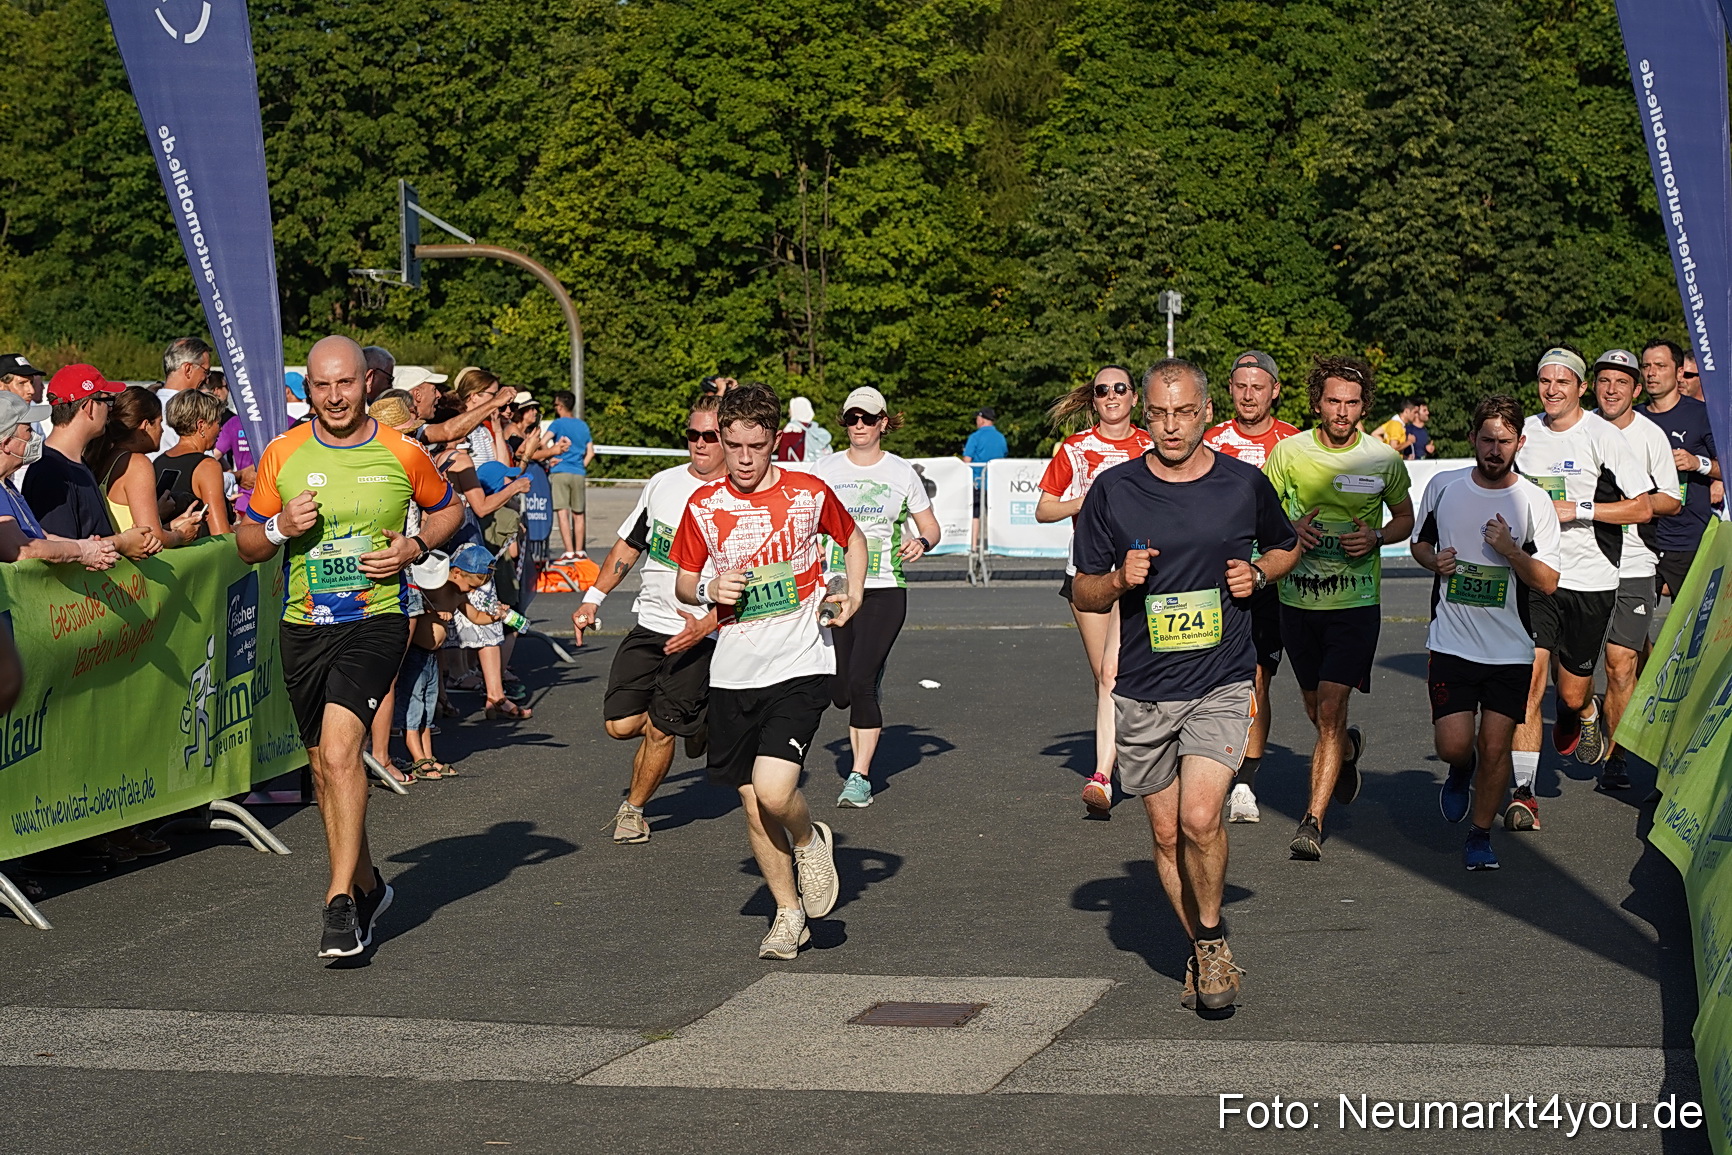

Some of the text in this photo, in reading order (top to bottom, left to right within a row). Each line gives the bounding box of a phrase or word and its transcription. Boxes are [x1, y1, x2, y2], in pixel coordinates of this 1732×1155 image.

[847, 505, 885, 513] aufend
[1012, 503, 1034, 513] E-B
[853, 513, 888, 524] olgreich
[323, 556, 358, 576] 588
[872, 554, 880, 571] 2022
[309, 566, 318, 584] RUN
[321, 574, 363, 584] Kujat Aleksej
[785, 580, 797, 605] 2022
[1462, 577, 1492, 594] 531
[1497, 582, 1505, 602] 2022
[764, 598, 790, 608] Vincent
[1164, 611, 1205, 633] 724
[1212, 612, 1220, 638] 2022
[1151, 617, 1160, 645] WALK
[1182, 630, 1214, 640] Reinhold
[11, 768, 156, 836] www.firmenlauf-oberpfalz.de
